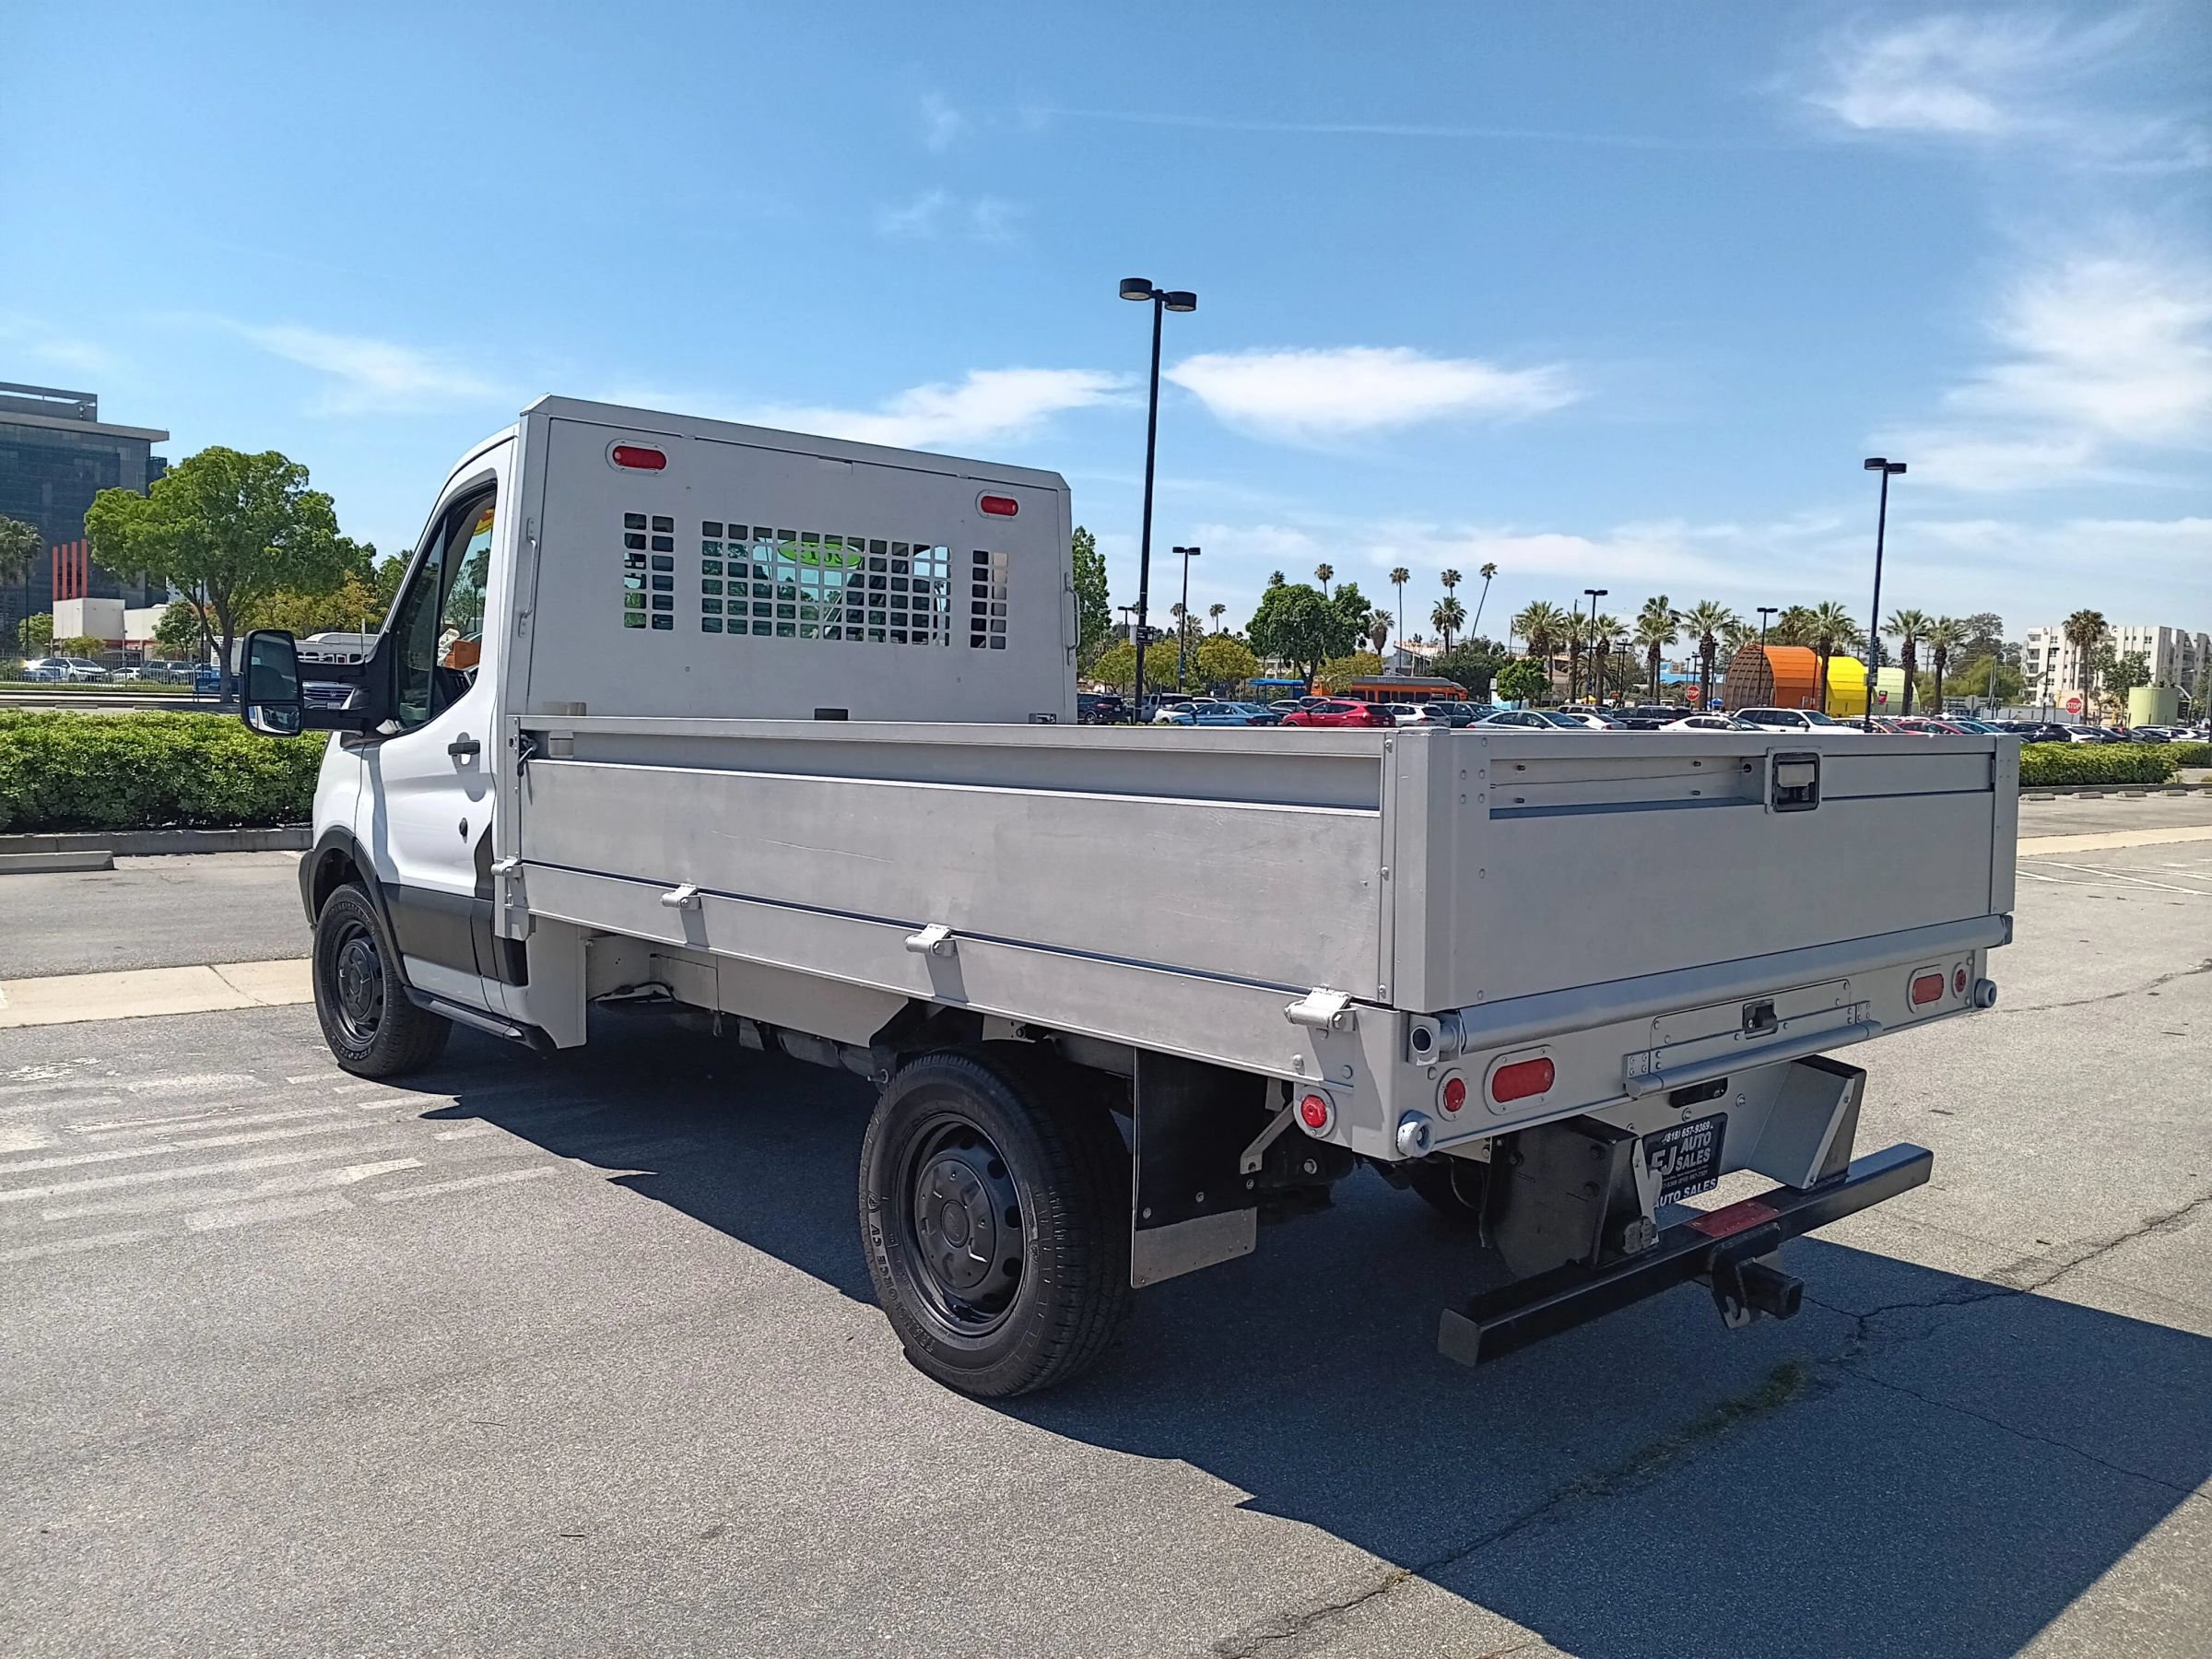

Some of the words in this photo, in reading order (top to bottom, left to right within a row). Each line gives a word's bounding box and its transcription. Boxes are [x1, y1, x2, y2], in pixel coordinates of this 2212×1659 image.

[2066, 701, 2081, 710] STOP
[1664, 1129, 1681, 1143] (818)
[1681, 1121, 1711, 1138] 657-9369
[1680, 1131, 1712, 1154] AUTO
[1676, 1147, 1711, 1171] SALES
[1683, 1178, 1717, 1198] SALES
